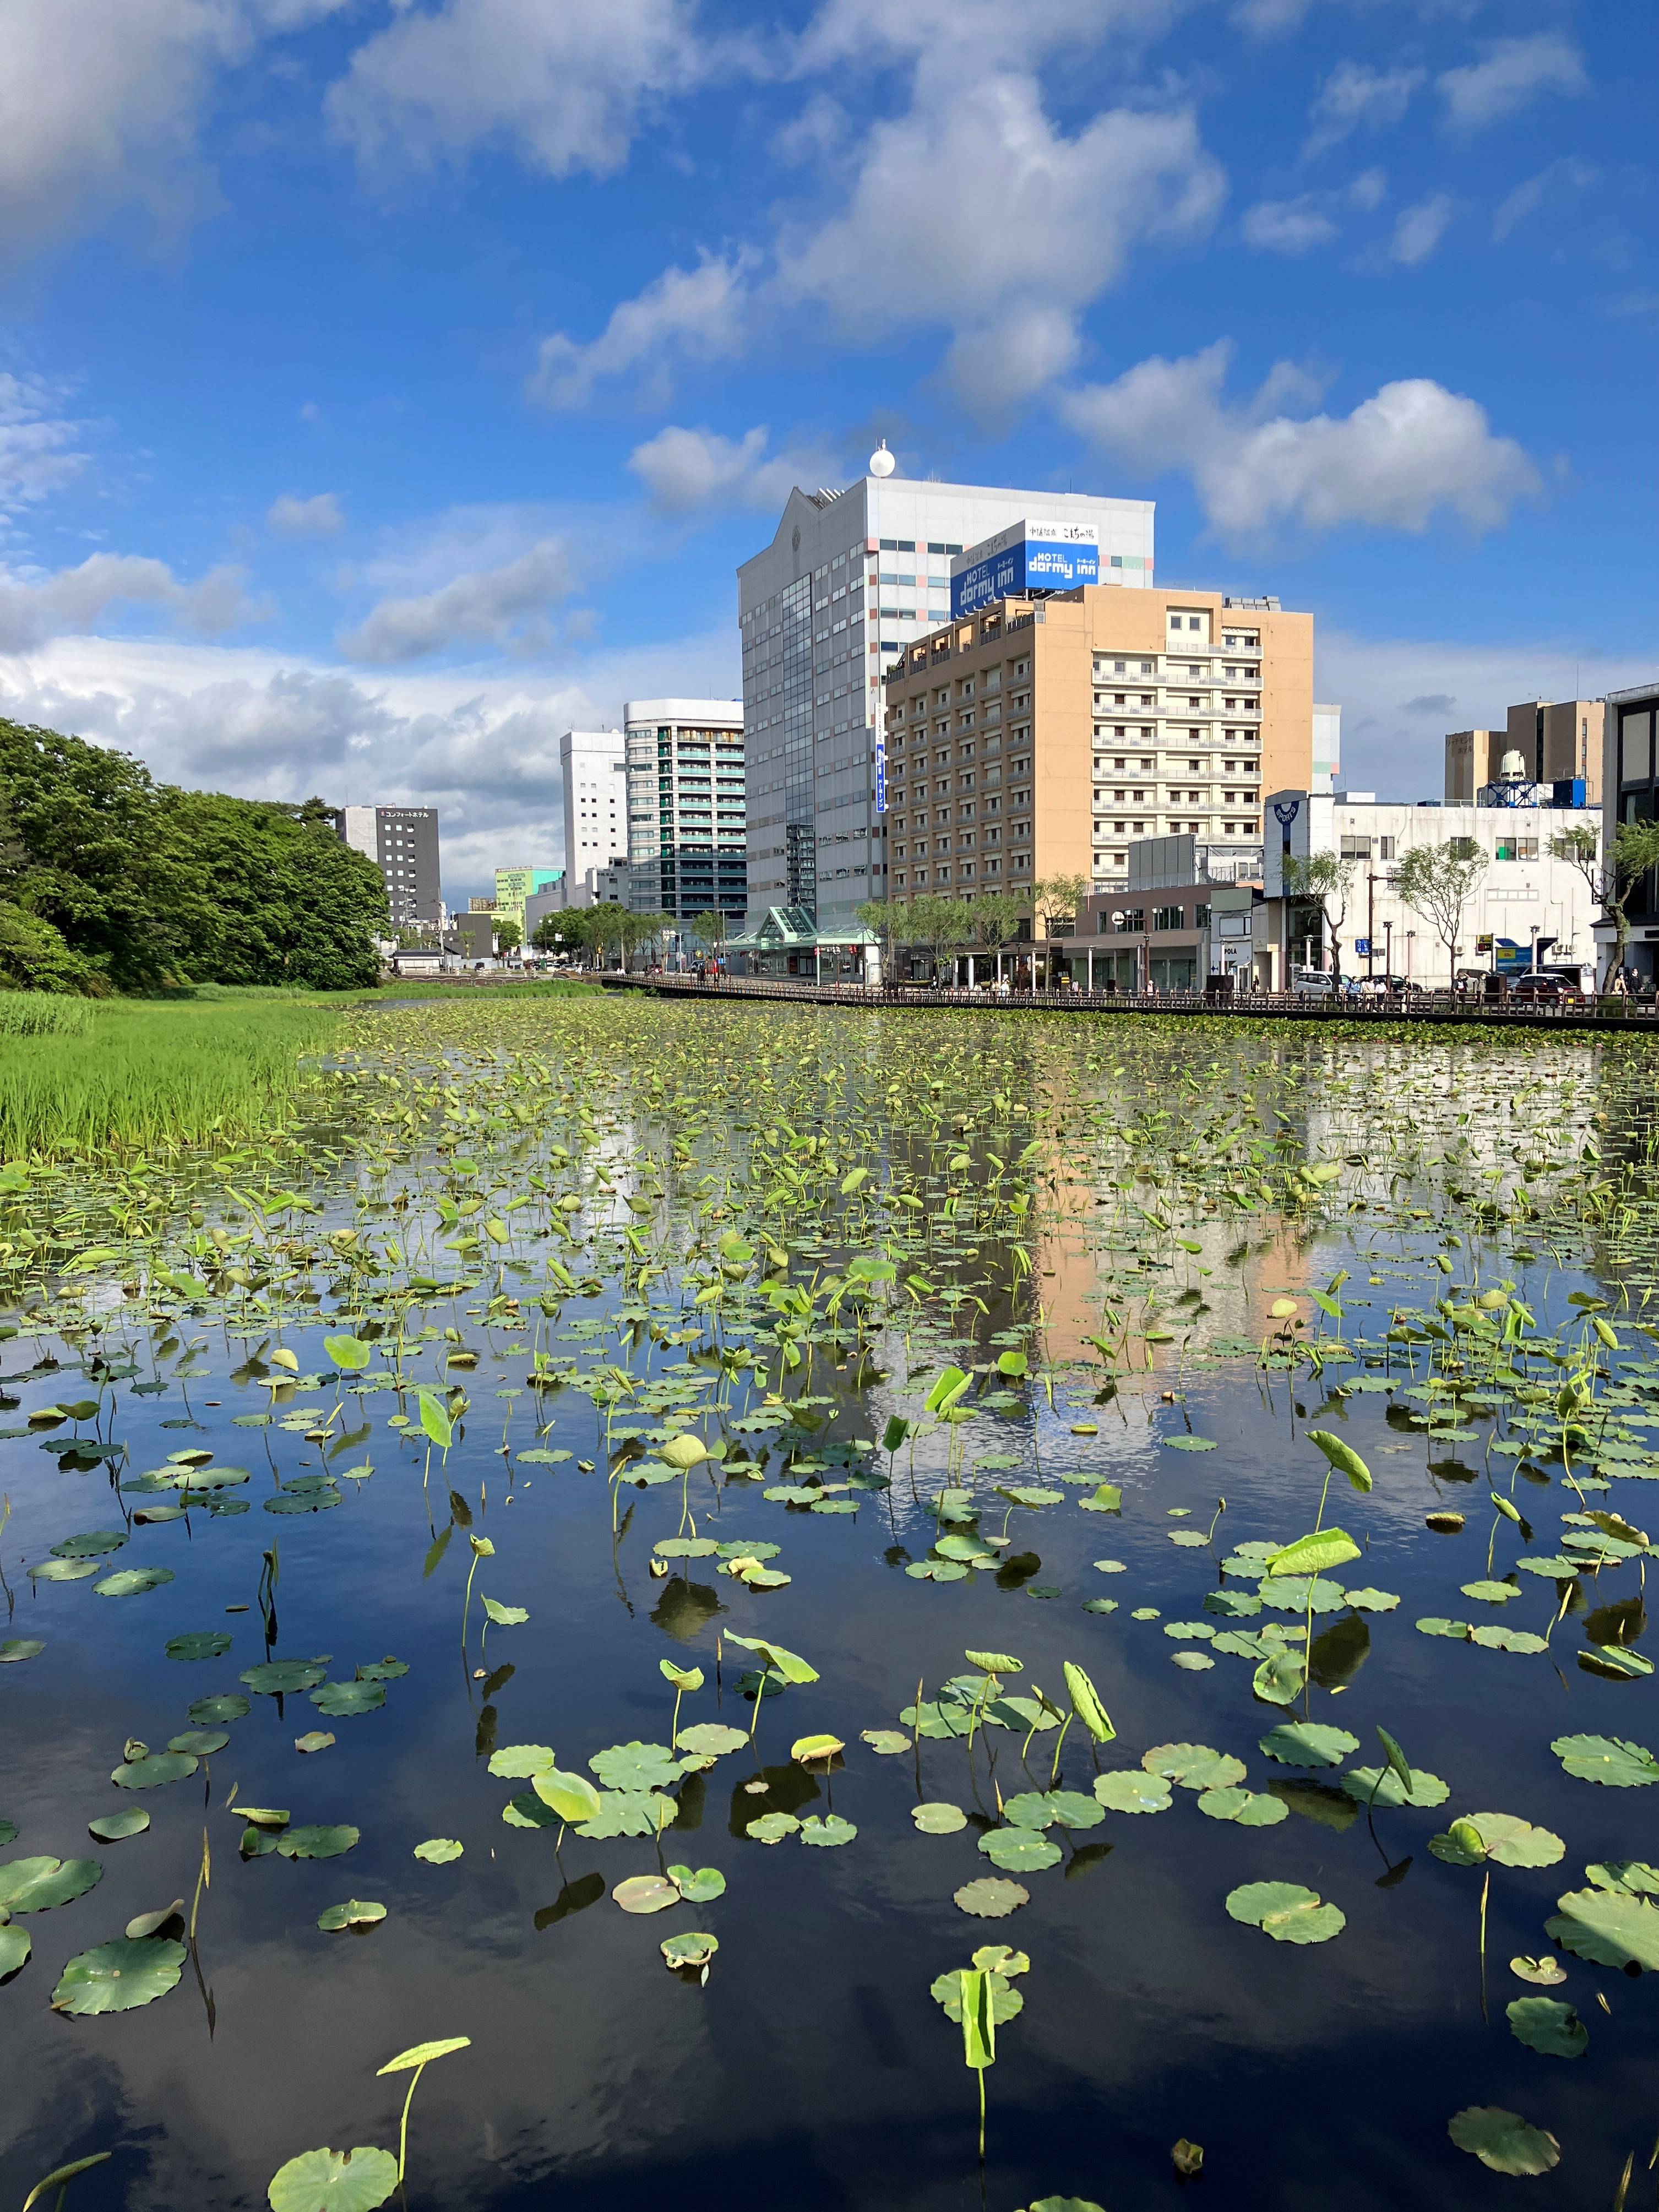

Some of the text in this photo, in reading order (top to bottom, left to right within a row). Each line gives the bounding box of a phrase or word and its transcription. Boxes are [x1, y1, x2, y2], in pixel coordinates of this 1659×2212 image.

[1037, 552, 1068, 563] HOTEL
[966, 564, 990, 585] HOTEL
[1029, 556, 1096, 579] dormy inn
[960, 566, 1013, 606] dormy inn
[1446, 736, 1473, 747] リッチモンド
[1457, 745, 1473, 754] ホテル
[1276, 806, 1296, 822] SPORTS
